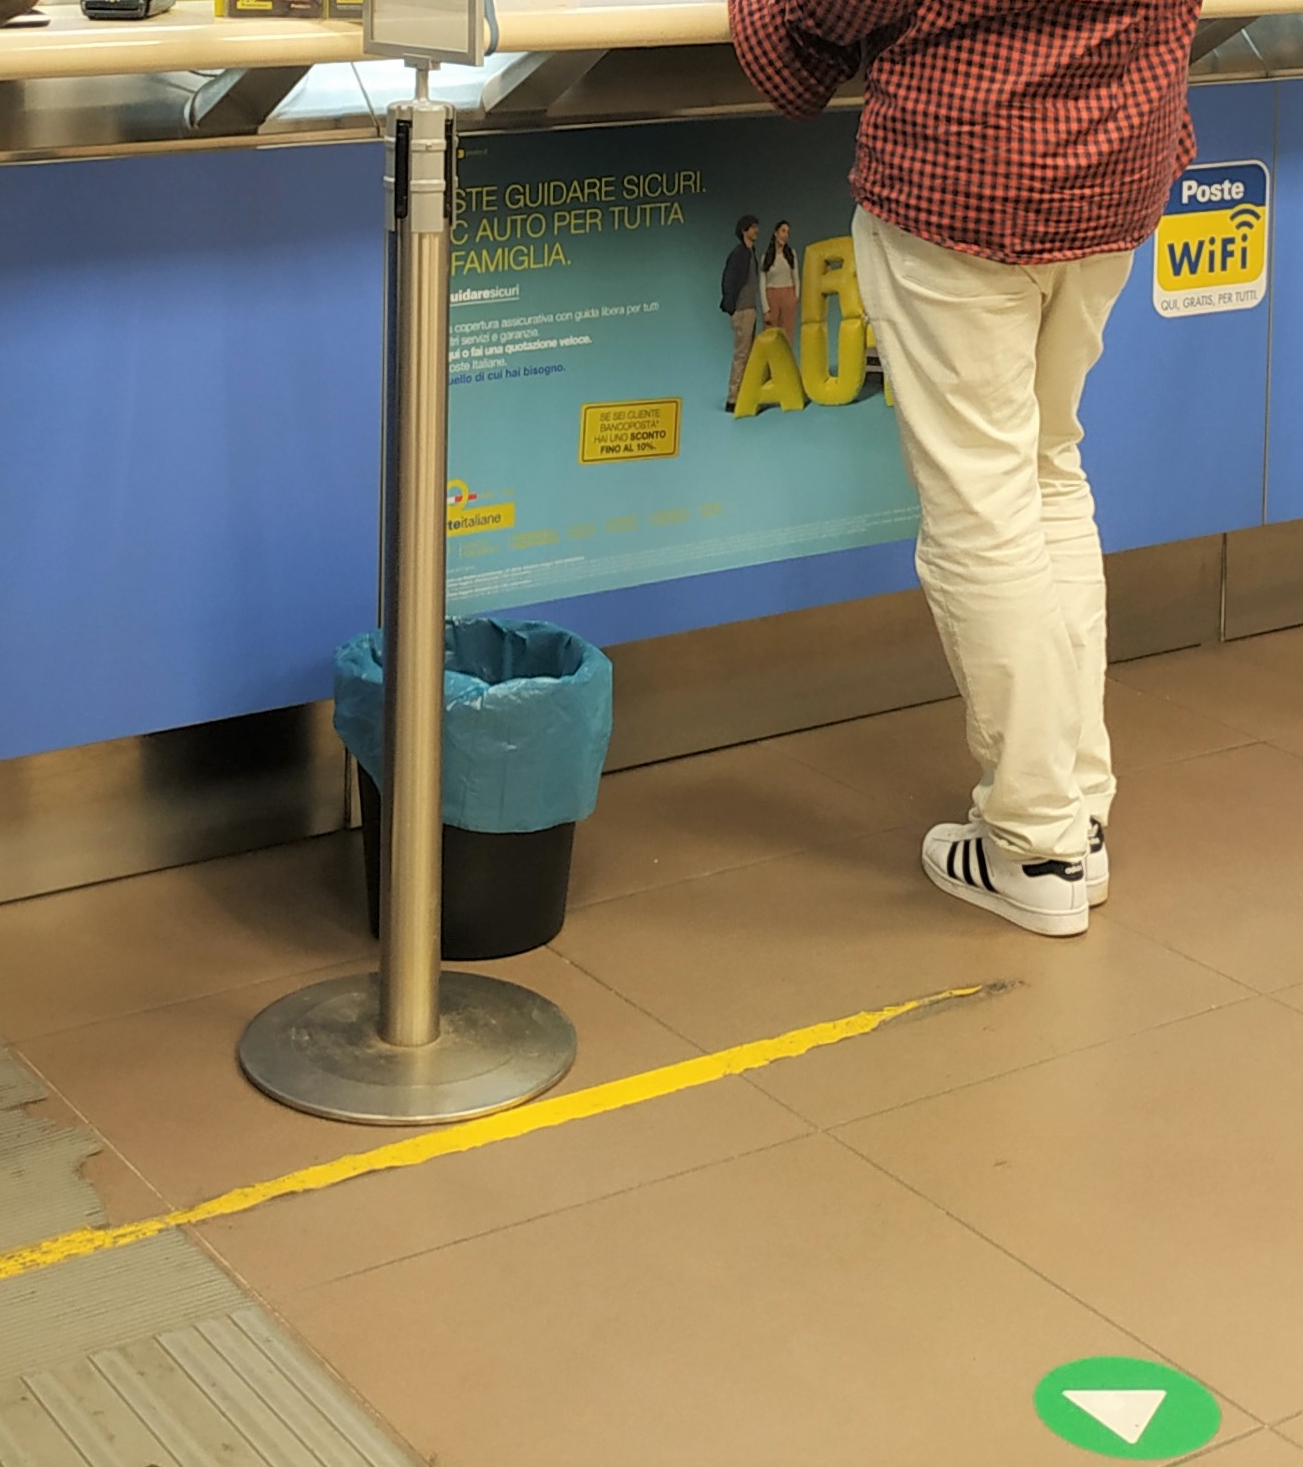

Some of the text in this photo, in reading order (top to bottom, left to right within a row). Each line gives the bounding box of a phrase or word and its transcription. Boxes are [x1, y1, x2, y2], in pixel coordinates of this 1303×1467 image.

[455, 171, 706, 214] STE GUIDARE SICURI.
[1181, 179, 1244, 204] Poste
[475, 213, 546, 243] AUTO
[554, 208, 602, 236] PER
[609, 202, 684, 230] TUTTA
[451, 242, 571, 276] FAMIGLIA.
[1167, 233, 1248, 277] WiFi
[801, 235, 864, 324] R
[450, 284, 520, 303] uidaresicuri
[1161, 299, 1180, 312] QUI,
[1183, 294, 1215, 308] GRATIS,
[1218, 292, 1233, 304] PER
[454, 319, 499, 333] copertura
[501, 311, 554, 327] assicurativa
[555, 310, 573, 322] con
[575, 307, 599, 322] guida
[601, 304, 625, 317] libera
[627, 303, 641, 316] per
[461, 332, 489, 345] servizi
[491, 333, 498, 342] e
[462, 349, 469, 358] o
[471, 345, 483, 357] fai
[485, 345, 503, 355] una
[505, 338, 557, 354] quotazione
[559, 334, 593, 348] veloce.
[449, 361, 470, 373] oste
[449, 363, 566, 385] uello di cui hai bisogno.
[600, 409, 660, 421] SE SEI CLIENTE
[594, 430, 666, 444] HAI UNO SCONTO
[600, 445, 621, 454] FINO
[623, 443, 634, 452] AL
[447, 512, 501, 531] teitaliane
